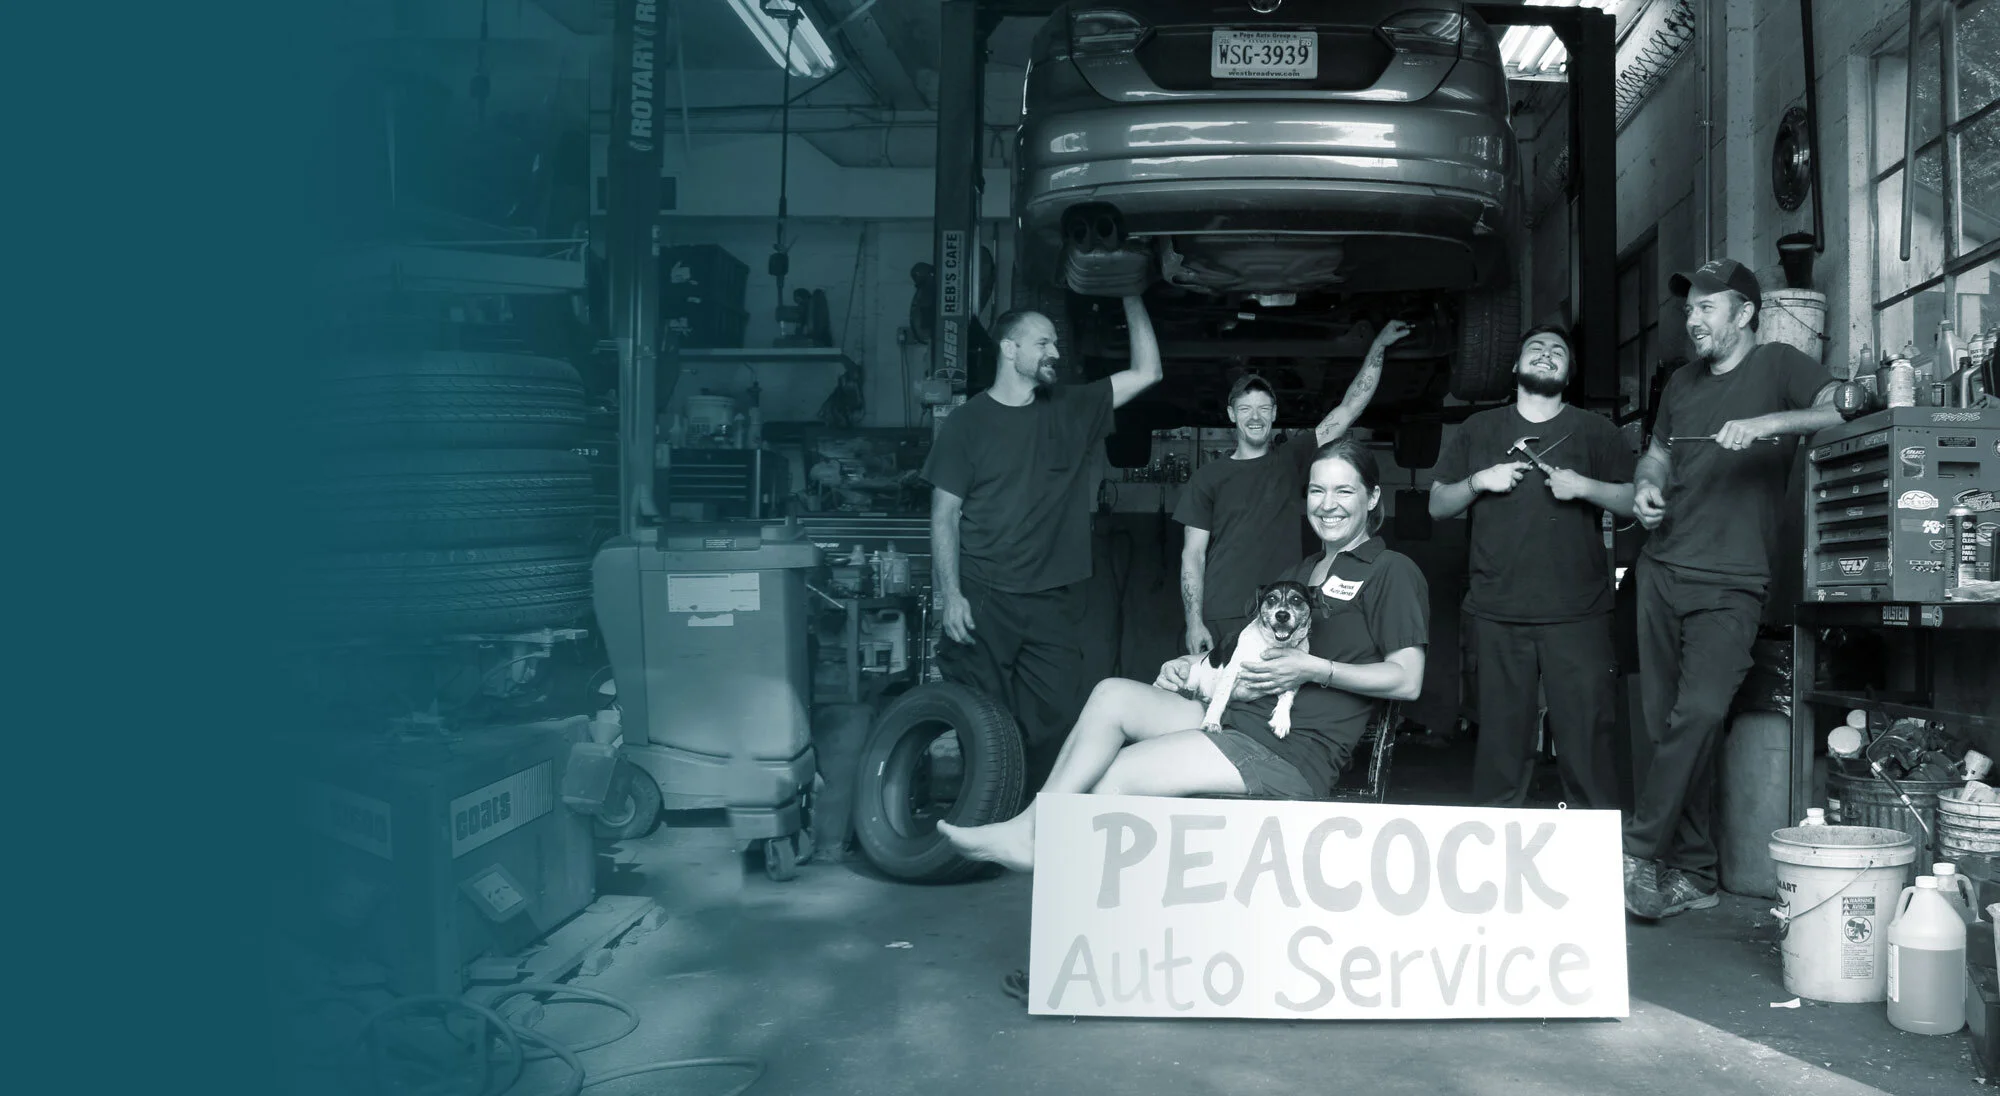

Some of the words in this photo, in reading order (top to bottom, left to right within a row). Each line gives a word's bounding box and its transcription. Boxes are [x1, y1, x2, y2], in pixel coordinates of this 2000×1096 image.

[1218, 44, 1309, 65] WSG-3939
[631, 37, 653, 137] ROTARY
[945, 233, 958, 269] CAFE
[944, 272, 957, 313] REB'S
[1882, 605, 1910, 621] BILSTEIN
[1092, 811, 1570, 916] PEACOCK
[1047, 927, 1244, 1011] Auto
[1274, 926, 1594, 1012] Service
